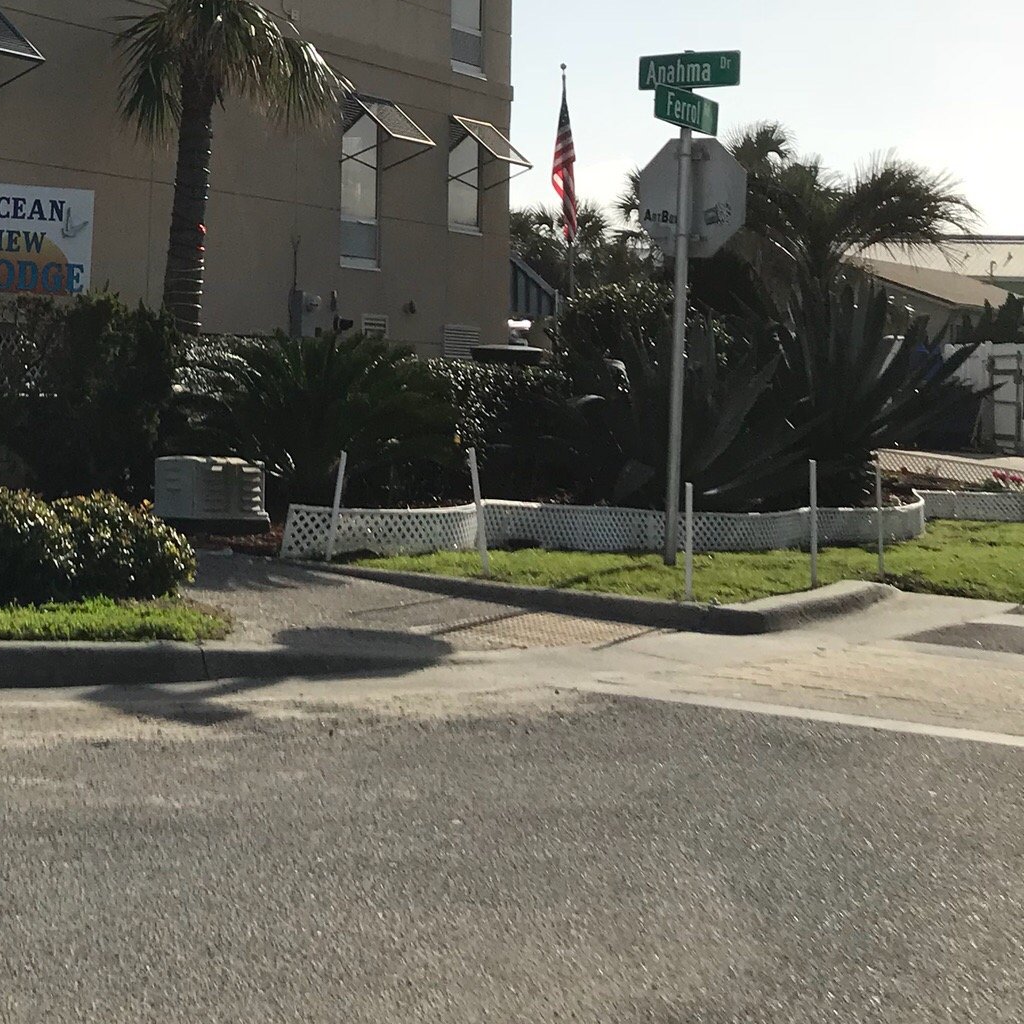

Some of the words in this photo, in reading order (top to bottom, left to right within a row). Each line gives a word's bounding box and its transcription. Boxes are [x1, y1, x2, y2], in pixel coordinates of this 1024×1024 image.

[646, 58, 712, 85] Anahma
[720, 56, 732, 70] Dr
[666, 91, 702, 125] Ferrol
